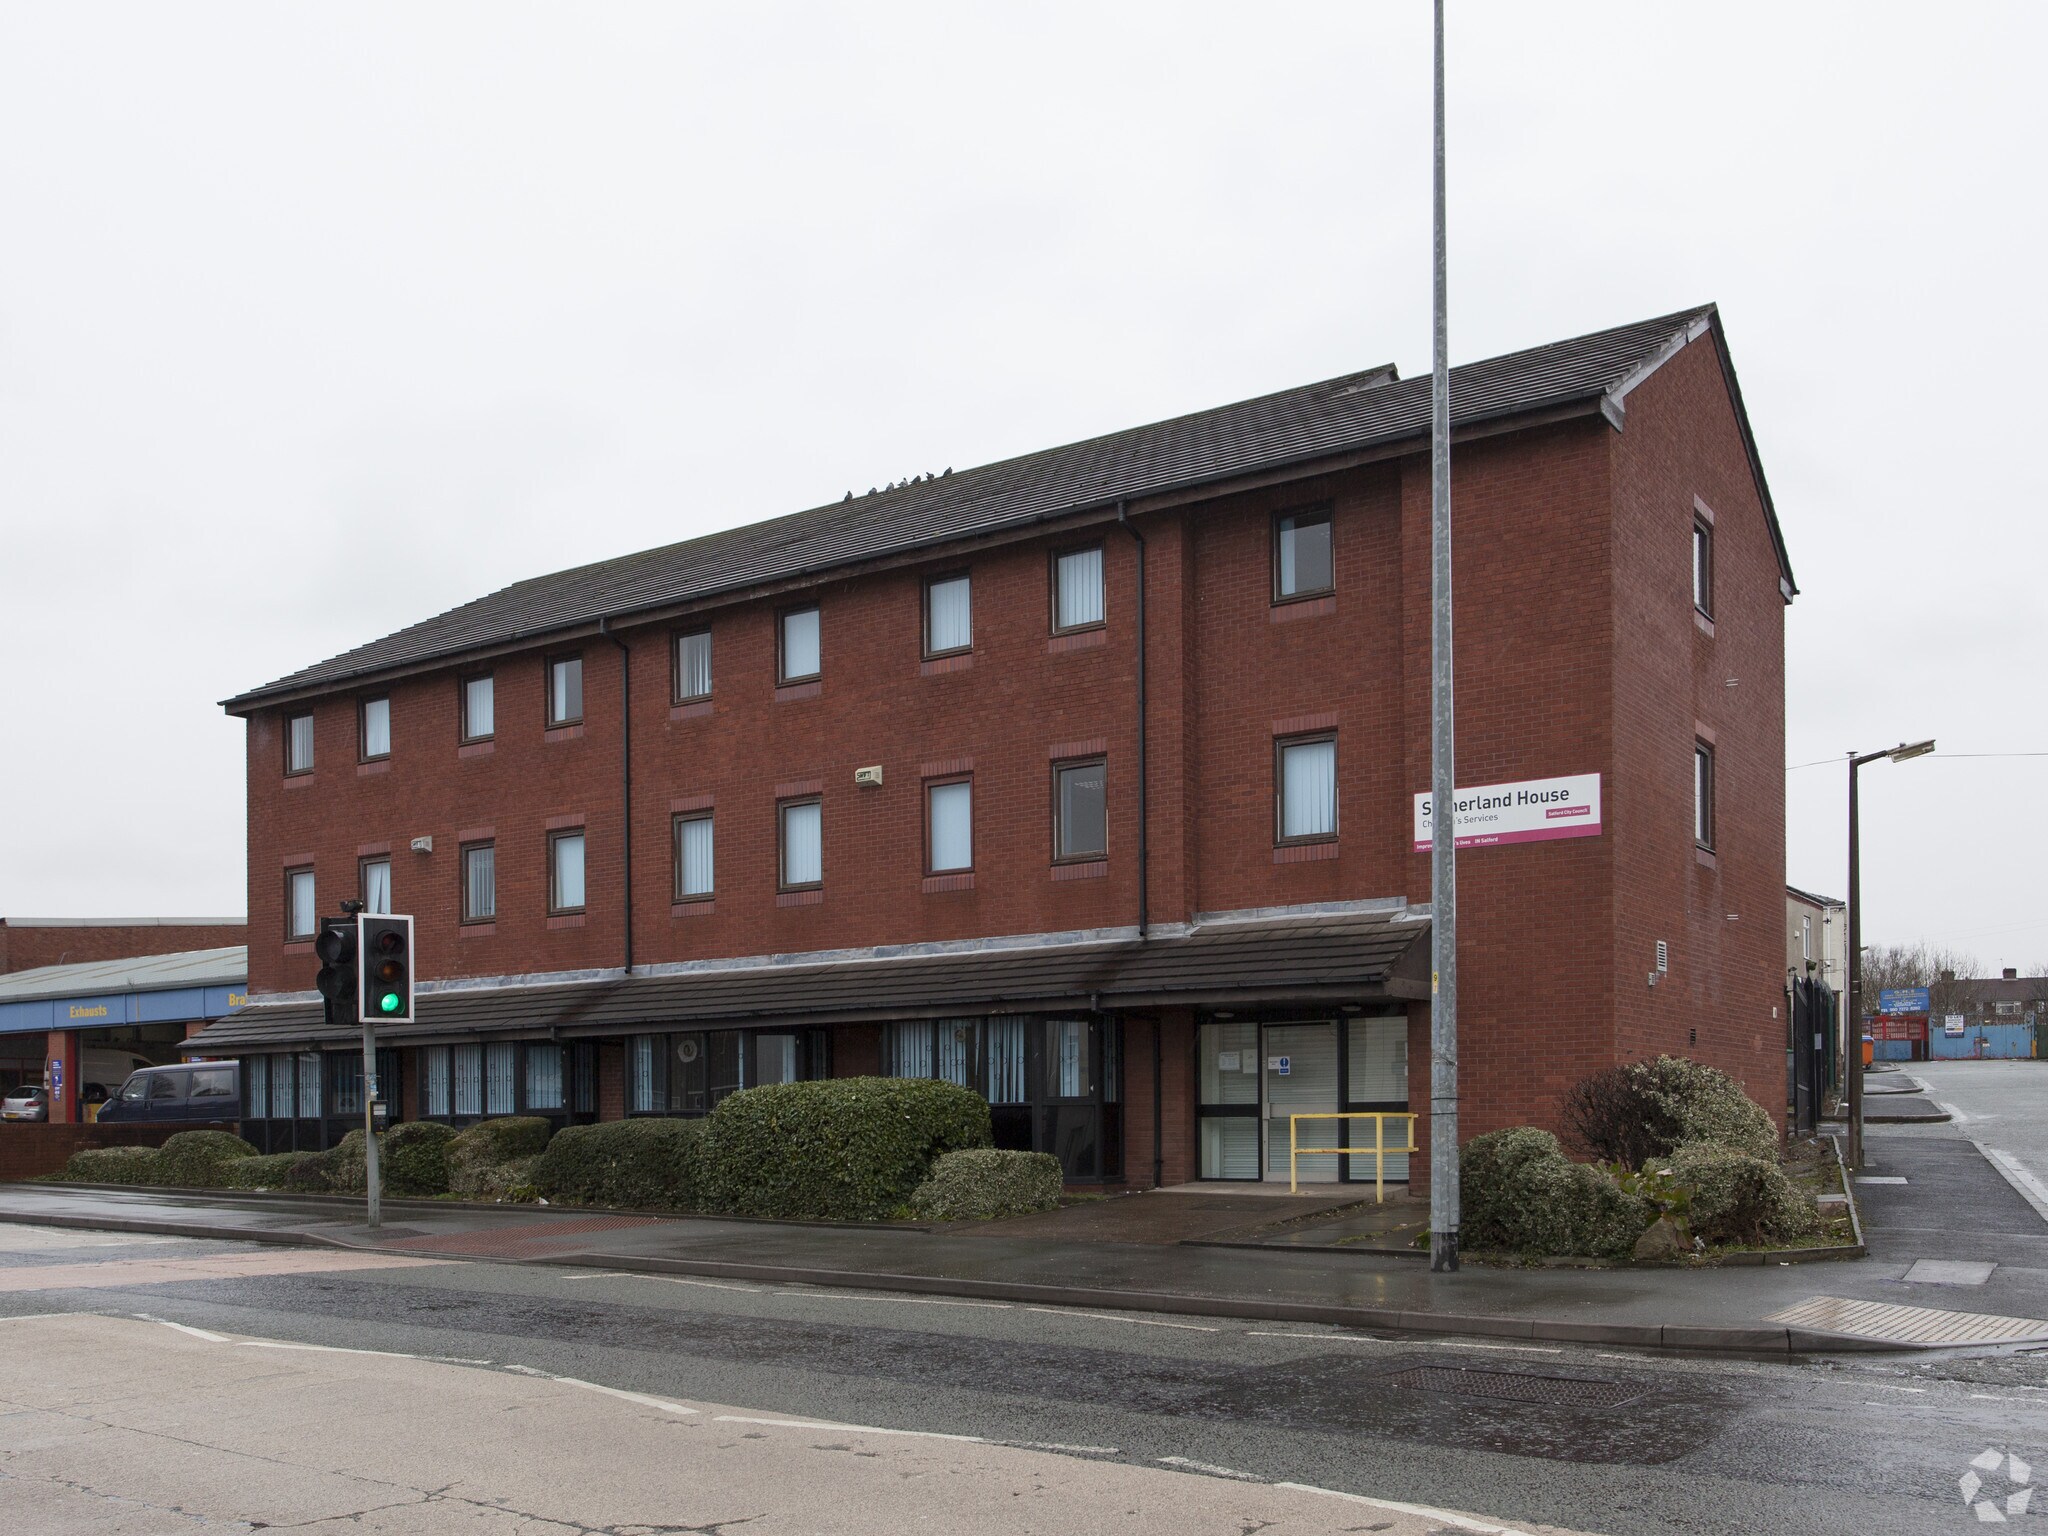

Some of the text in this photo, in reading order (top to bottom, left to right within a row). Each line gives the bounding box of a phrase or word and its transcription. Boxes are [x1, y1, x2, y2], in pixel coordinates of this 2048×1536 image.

[1422, 789, 1570, 816] Serland House
[1464, 813, 1499, 824] Services
[228, 992, 247, 1007] Bra
[69, 1005, 107, 1018] Exhausts
